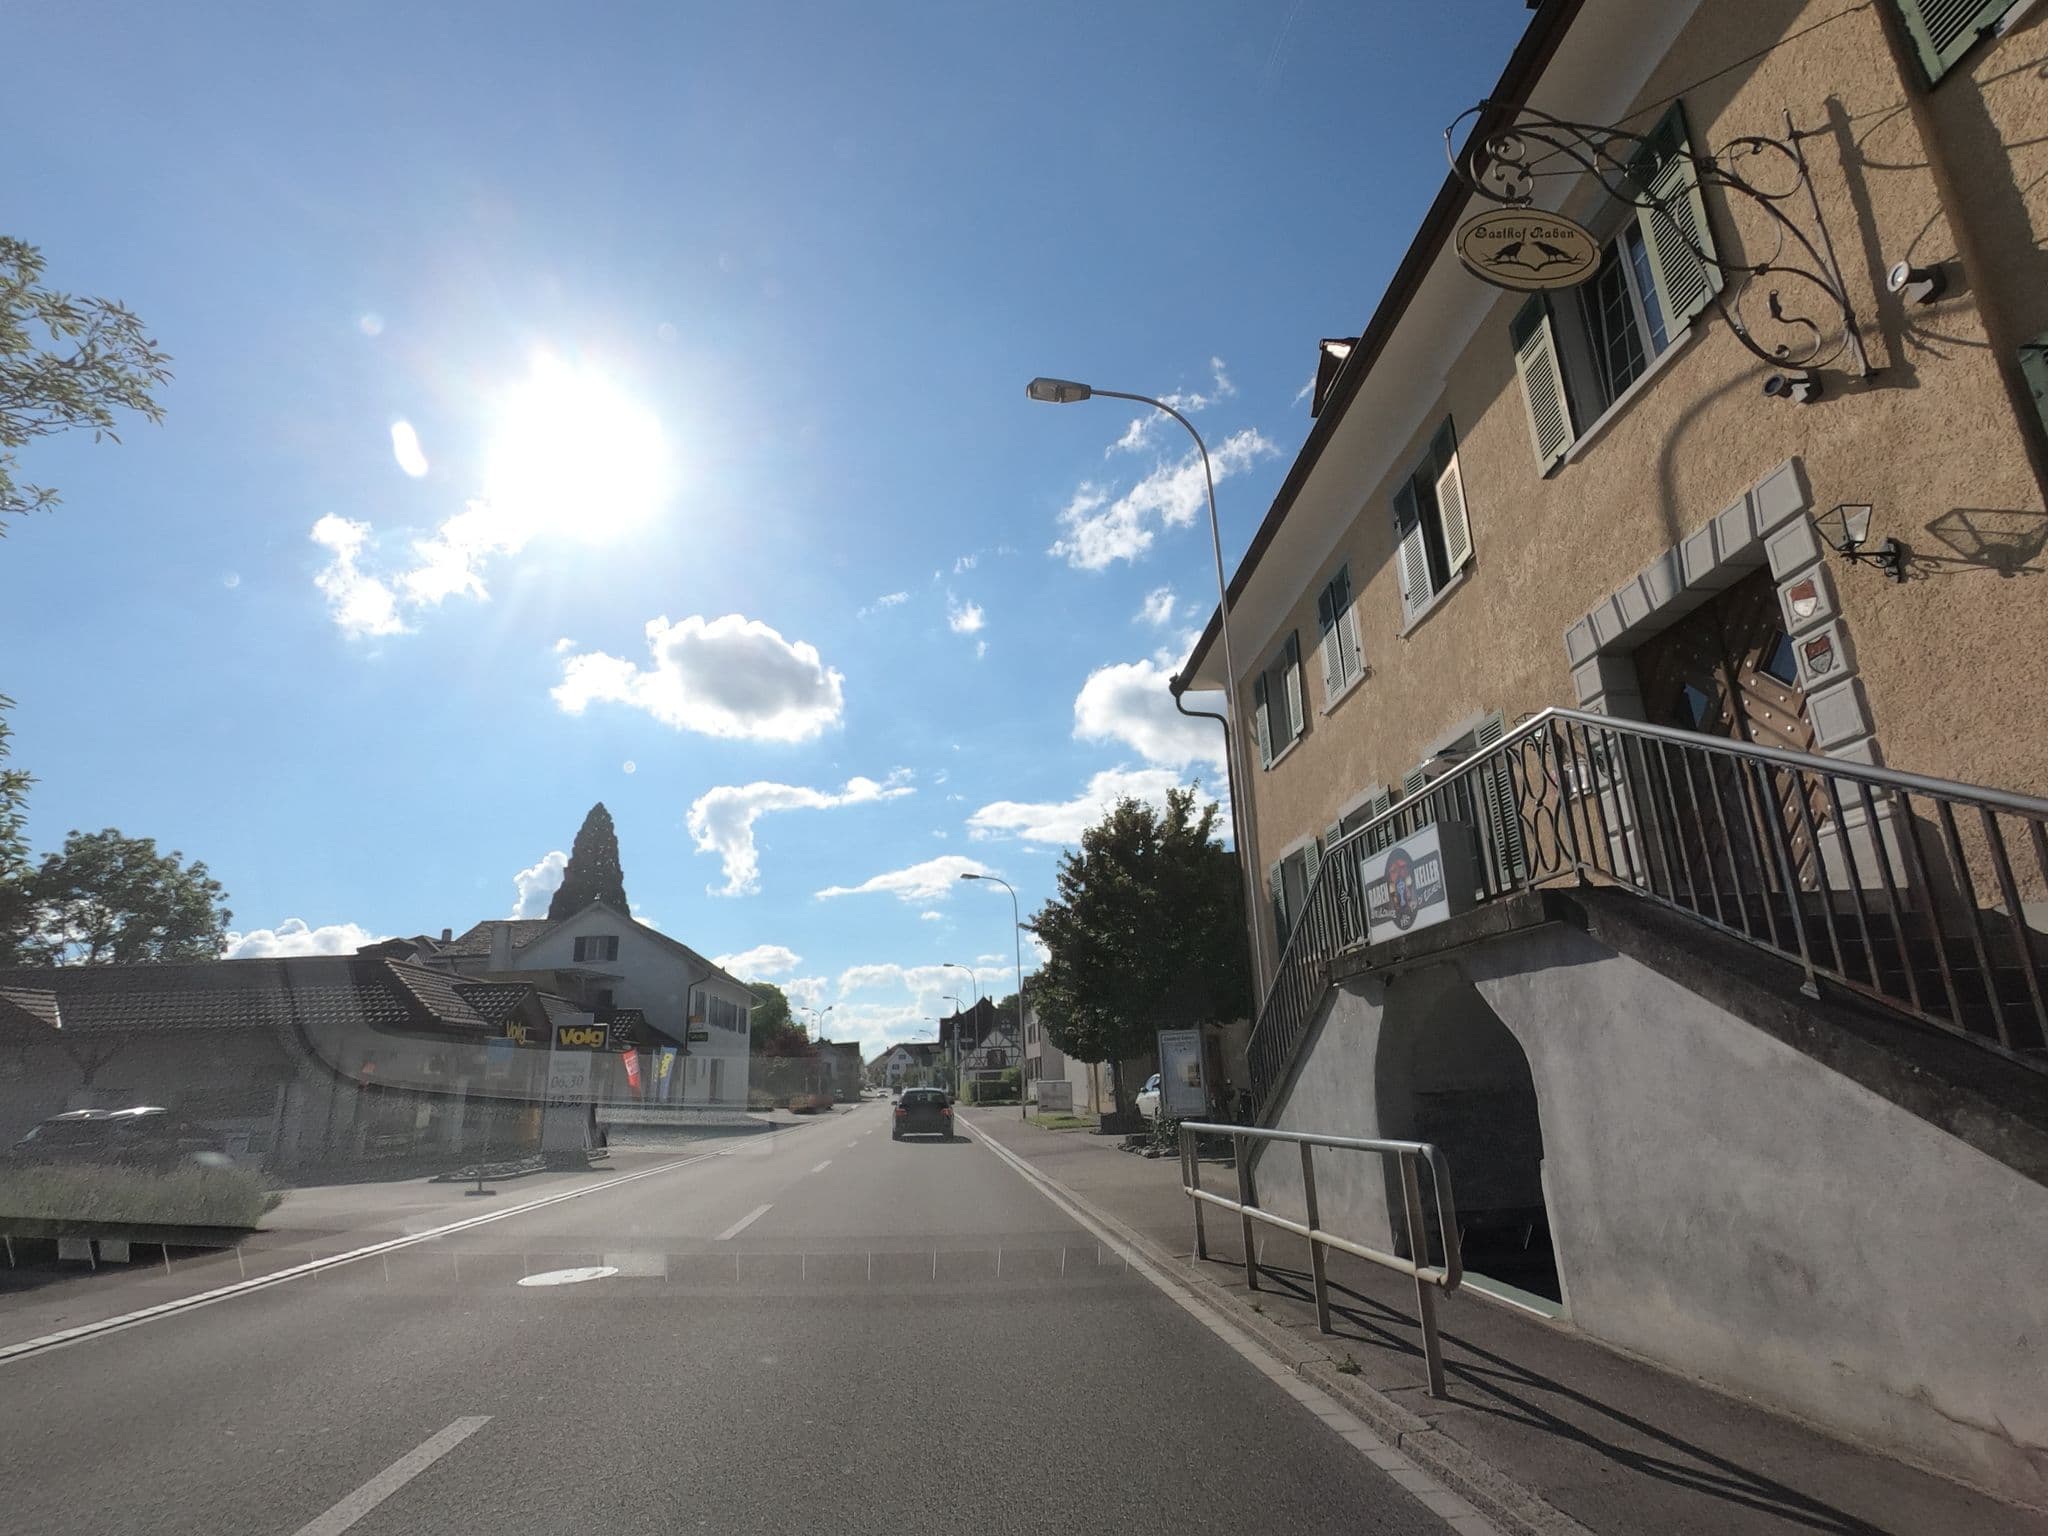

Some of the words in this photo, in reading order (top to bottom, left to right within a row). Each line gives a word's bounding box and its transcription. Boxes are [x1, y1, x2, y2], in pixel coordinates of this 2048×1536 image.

[1475, 227, 1526, 241] Gasthof
[1414, 860, 1440, 889] KELLER
[506, 1020, 526, 1044] Volg
[559, 1028, 604, 1047] Volg
